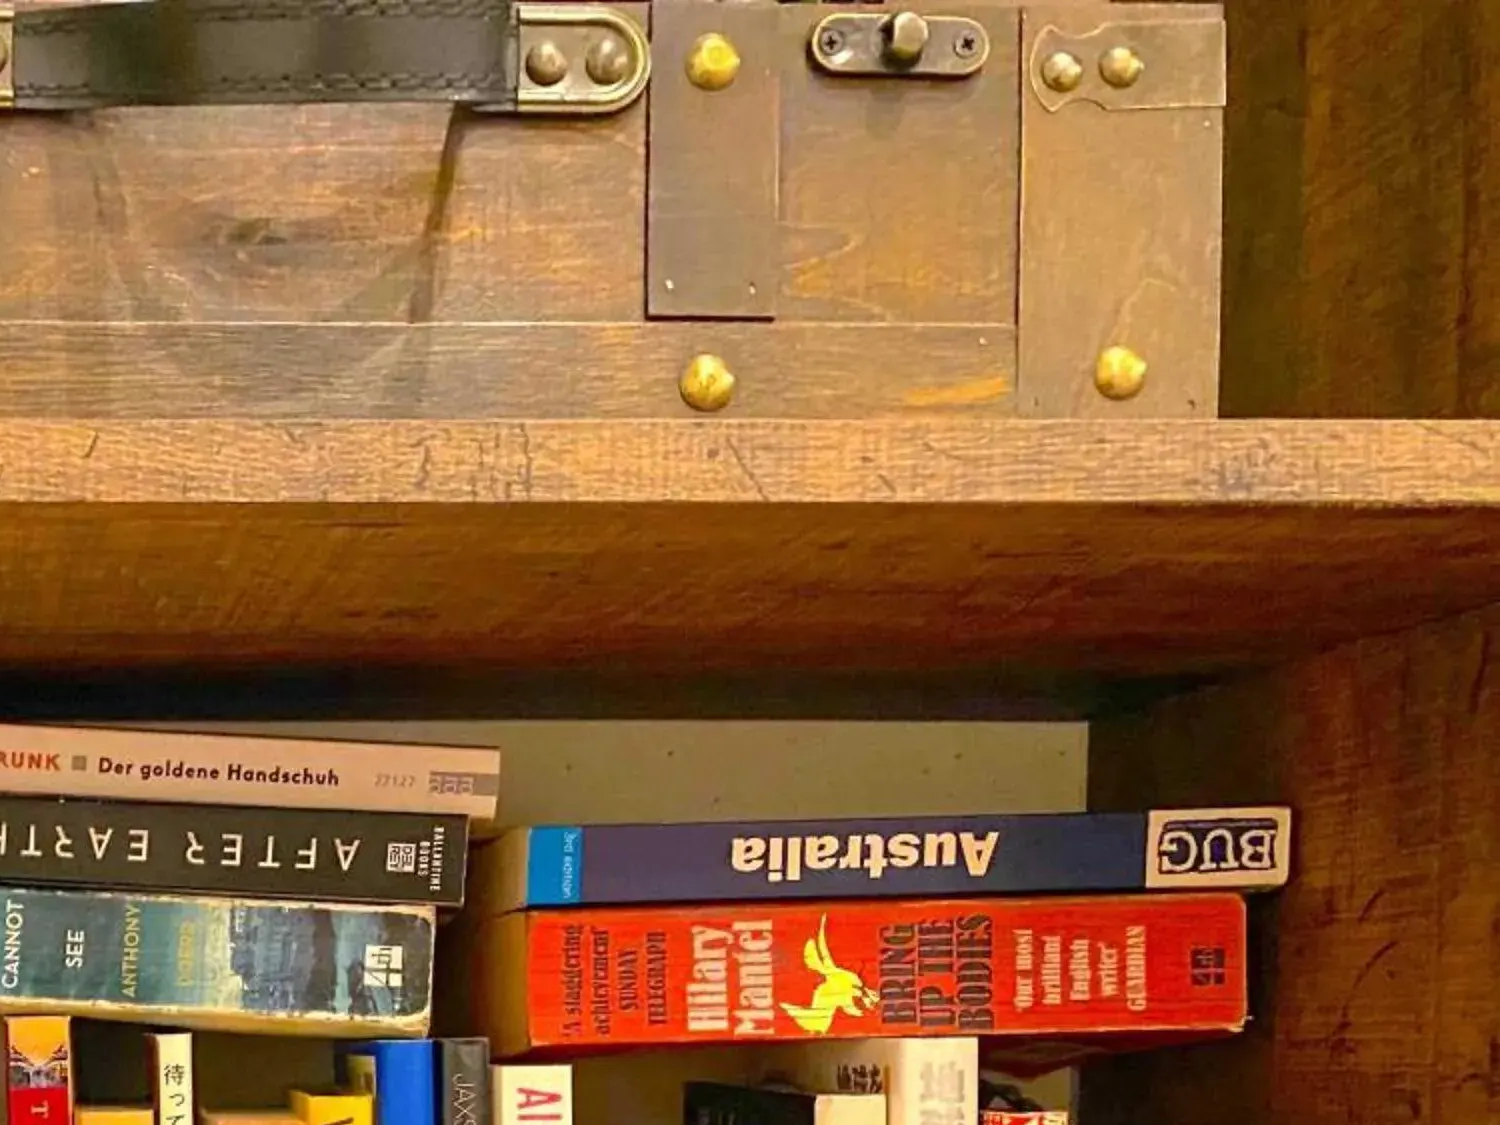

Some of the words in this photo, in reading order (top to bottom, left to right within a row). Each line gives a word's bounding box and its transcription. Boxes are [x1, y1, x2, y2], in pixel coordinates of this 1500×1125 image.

[99, 757, 133, 776] Der
[140, 760, 220, 788] goldene
[227, 763, 340, 787] Handschuh
[186, 832, 362, 872] AFTER
[731, 830, 1000, 883] Australia
[1159, 828, 1276, 874] BUG
[1, 899, 25, 989] CANNOT
[65, 929, 85, 968] SEE
[120, 904, 142, 998] ANTHONY
[646, 930, 668, 1026] TELEGRAPH
[686, 924, 735, 1032] Hilary
[733, 919, 775, 1036] Mantel
[879, 922, 916, 1025] BRING
[918, 916, 954, 974] THE
[956, 913, 994, 1031] BODIES
[1042, 935, 1062, 1006] brilliant
[1069, 939, 1091, 1001] English
[1125, 925, 1147, 1012] GUARDIAN
[618, 946, 638, 1012] SUNDAY
[919, 985, 956, 1027] UP
